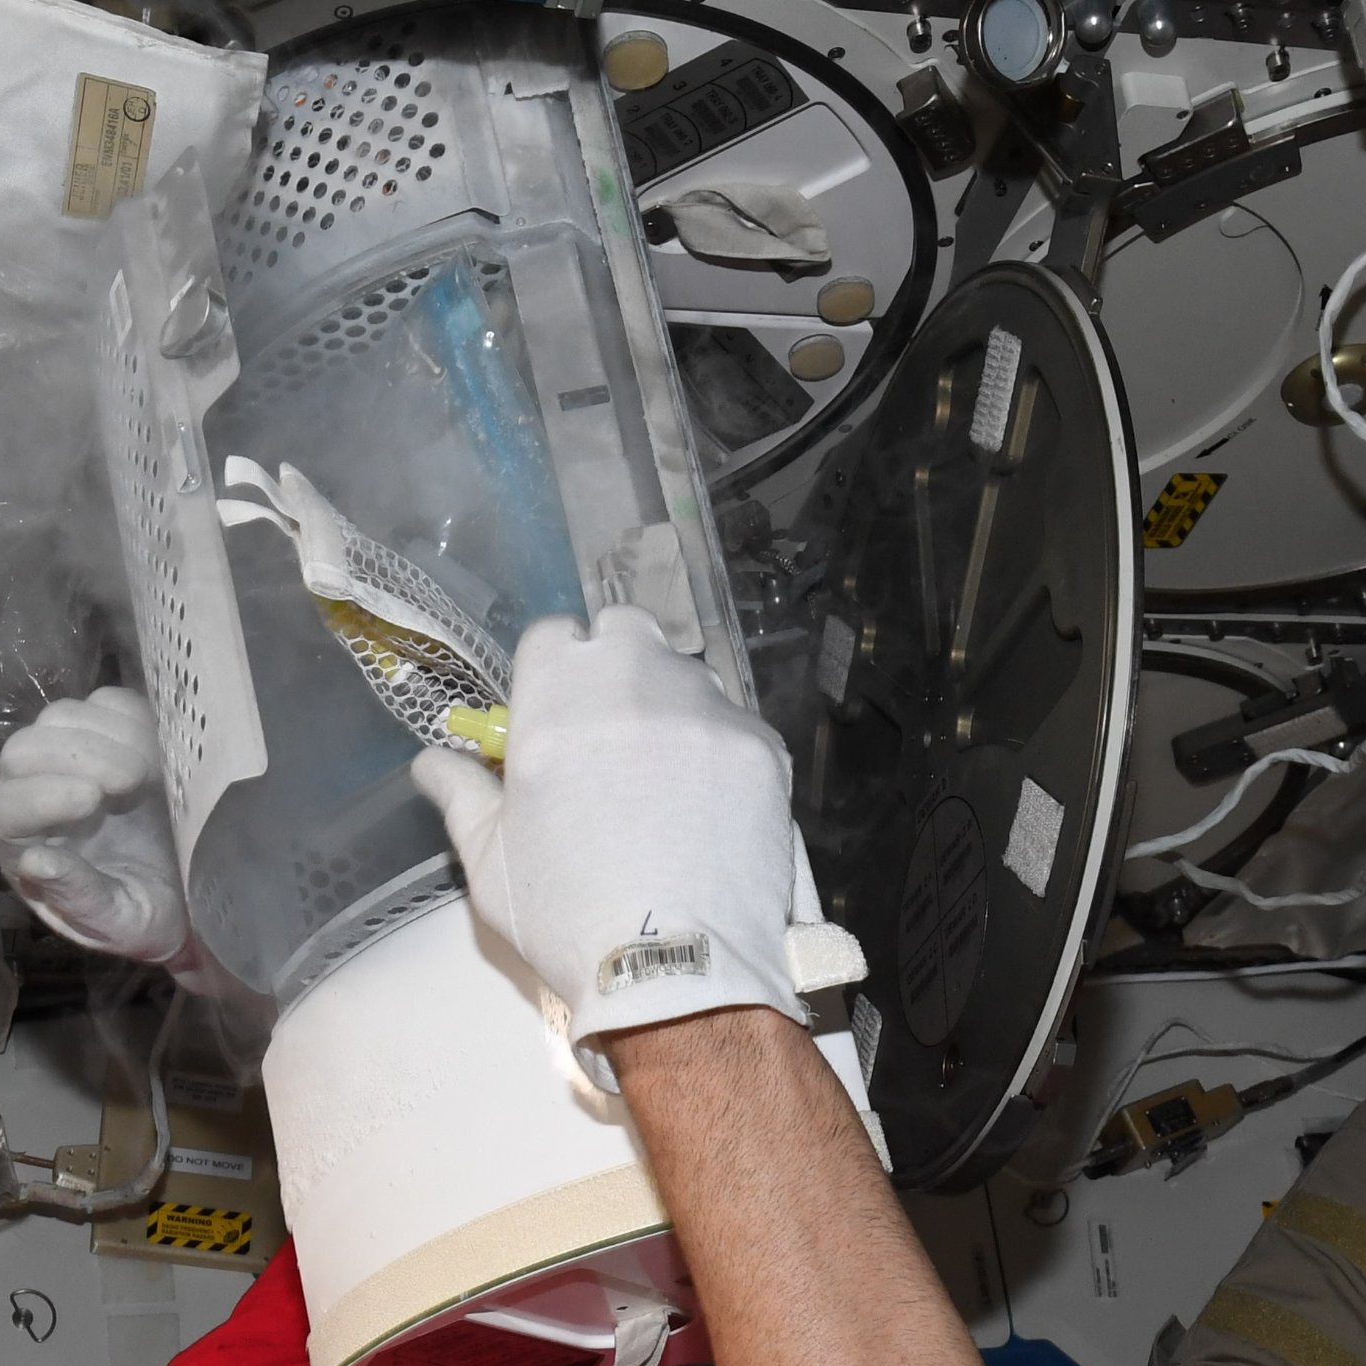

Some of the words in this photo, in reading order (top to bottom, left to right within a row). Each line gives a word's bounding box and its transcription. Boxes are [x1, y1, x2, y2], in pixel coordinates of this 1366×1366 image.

[718, 55, 733, 70] 4
[671, 78, 686, 93] 3
[626, 101, 641, 116] 2
[639, 908, 662, 938] L
[186, 1156, 209, 1166] NOT
[211, 1159, 242, 1170] MOVE
[166, 1214, 211, 1226] WARNING
